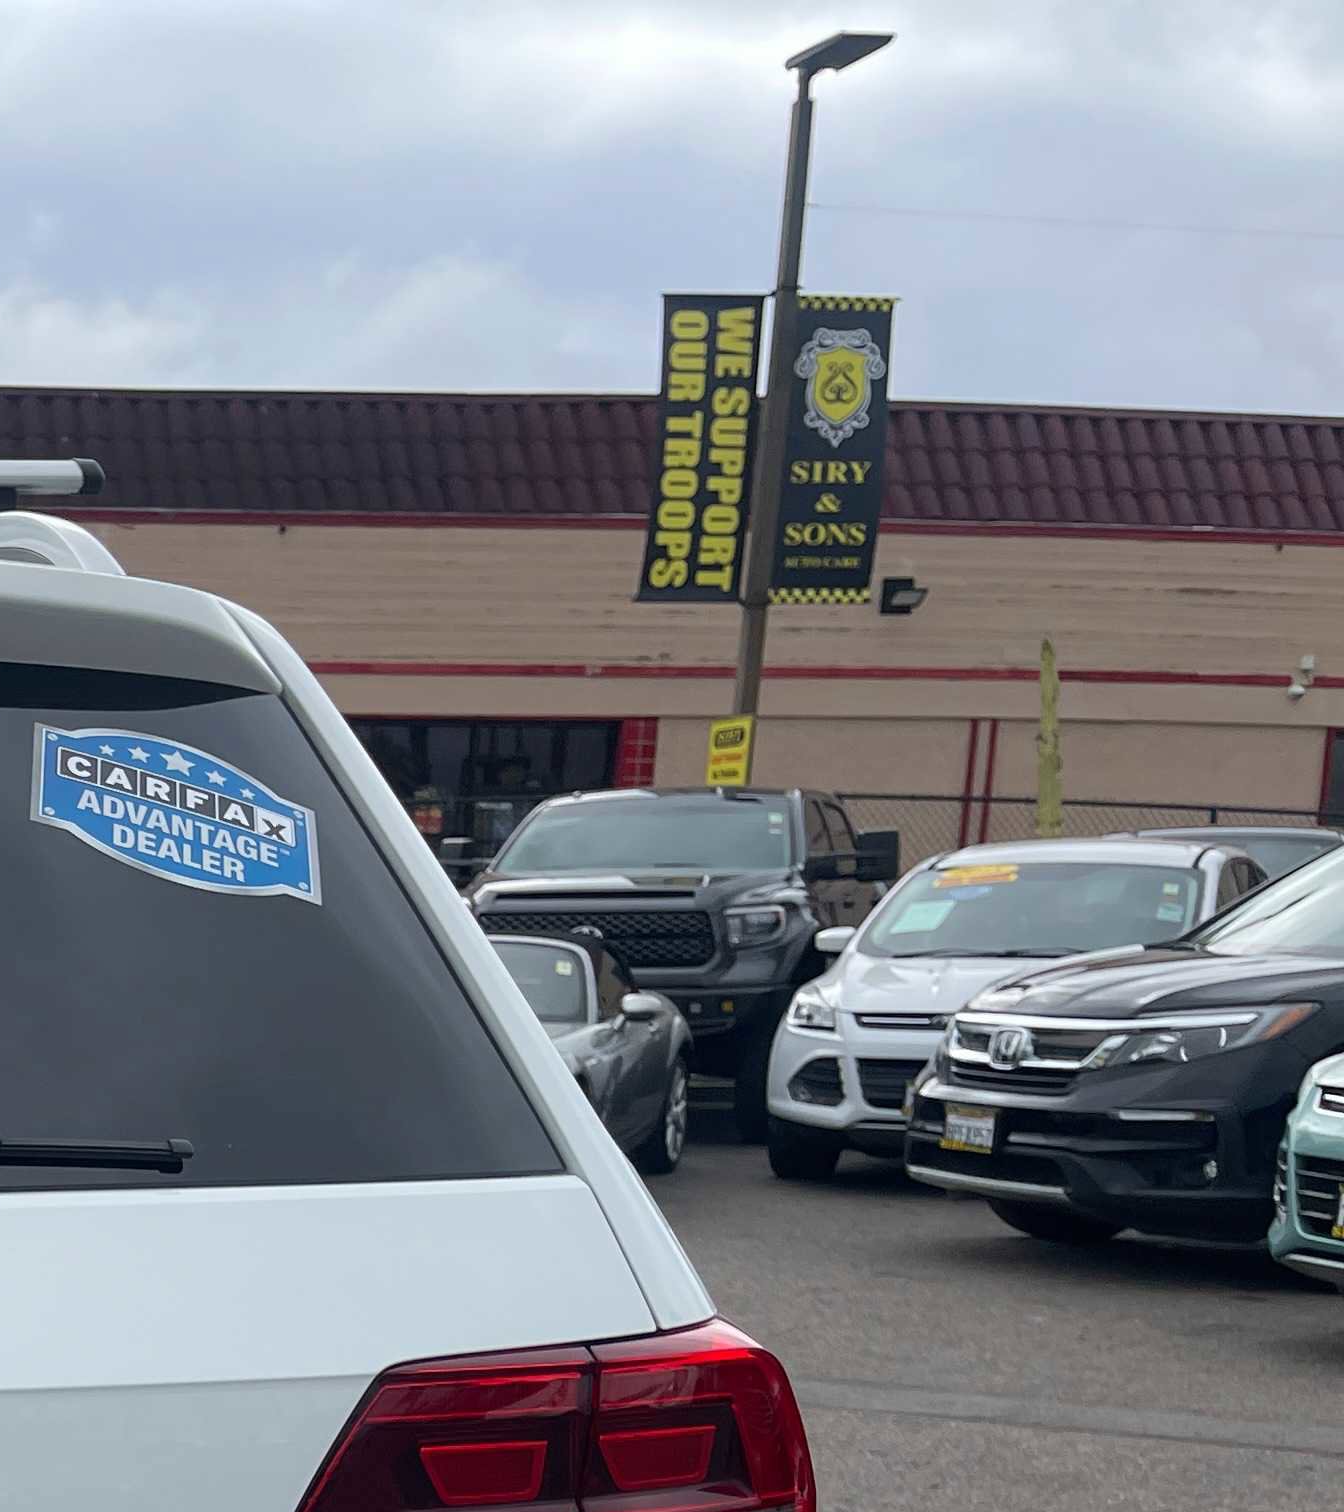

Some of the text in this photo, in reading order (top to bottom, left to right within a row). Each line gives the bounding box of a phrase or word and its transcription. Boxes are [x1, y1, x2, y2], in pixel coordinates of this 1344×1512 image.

[649, 309, 709, 589] OUR TROOPS
[695, 306, 755, 593] WE SUPPORT
[790, 460, 872, 485] SIRY
[784, 522, 866, 547] SONS
[814, 492, 841, 513] &
[66, 756, 287, 844] CARFAX
[77, 789, 280, 868] ADVANTAGE
[113, 823, 246, 882] DEALER
